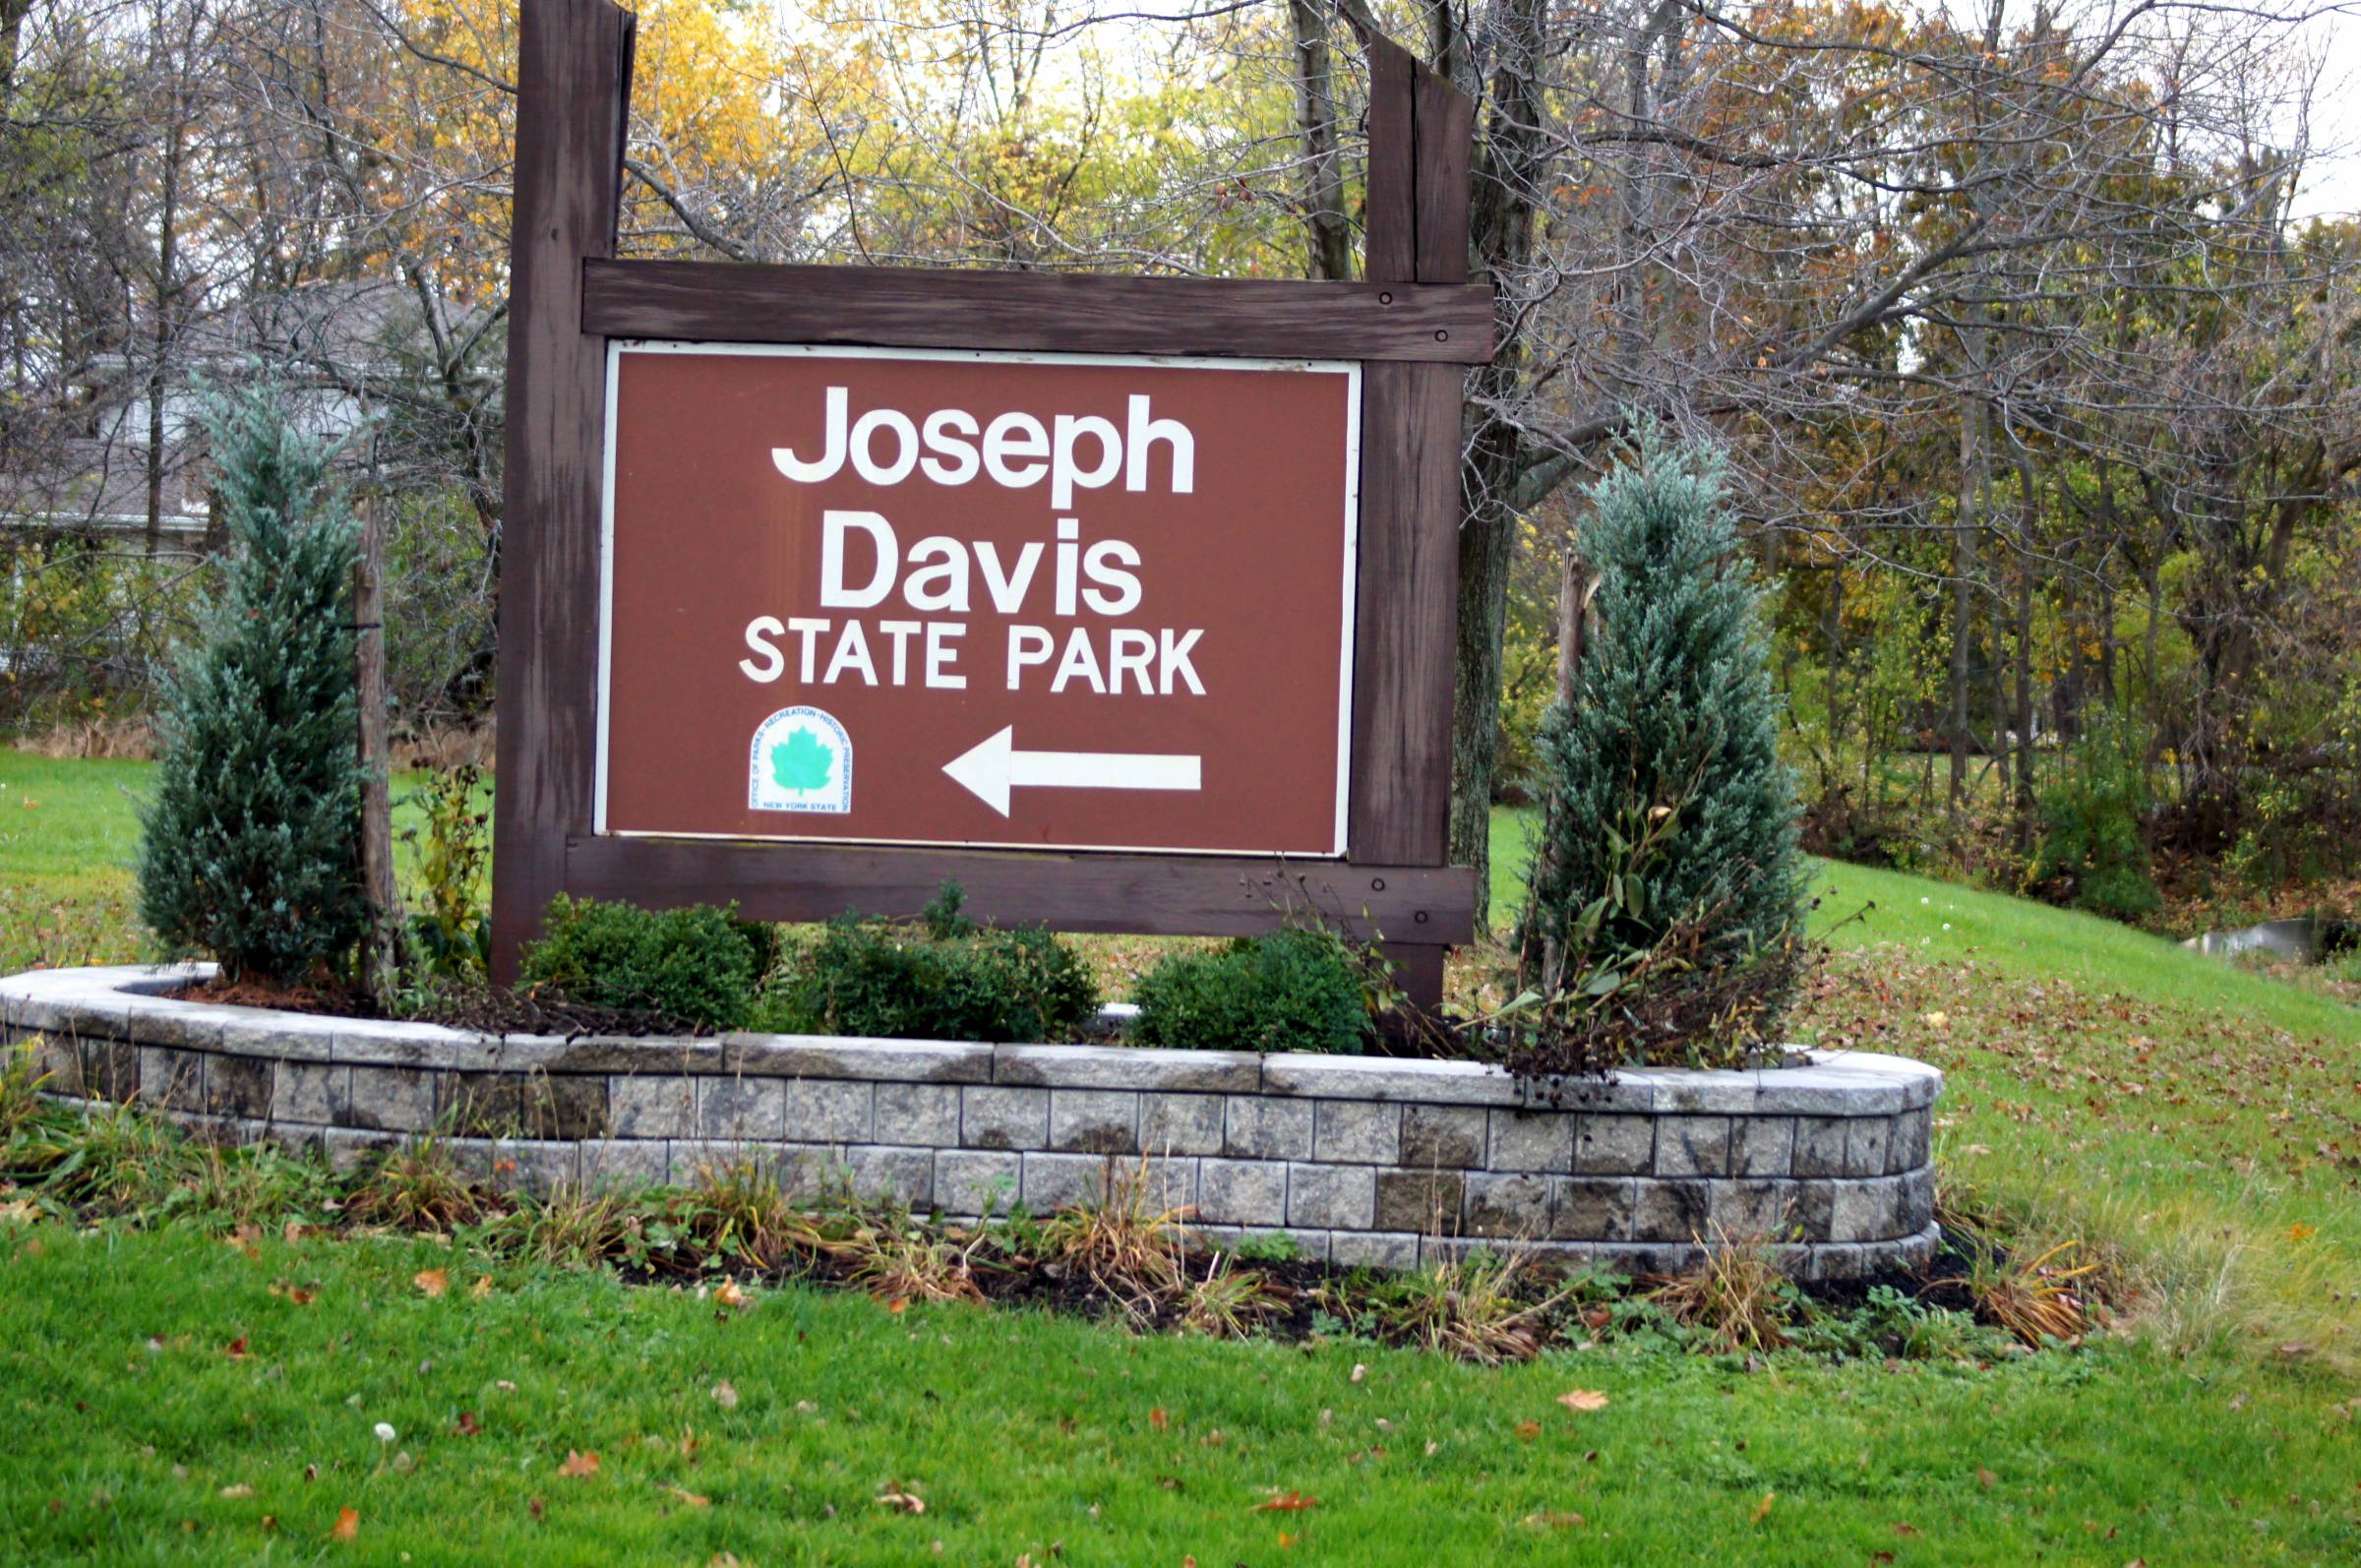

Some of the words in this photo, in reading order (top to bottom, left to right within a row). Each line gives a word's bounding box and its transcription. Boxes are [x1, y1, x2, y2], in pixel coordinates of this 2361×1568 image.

[770, 386, 1195, 511] Joseph
[819, 510, 1142, 617] Davis
[739, 615, 967, 690] STATE
[1006, 624, 1207, 695] PARK
[763, 801, 782, 810] NEW
[810, 803, 837, 812] STATE
